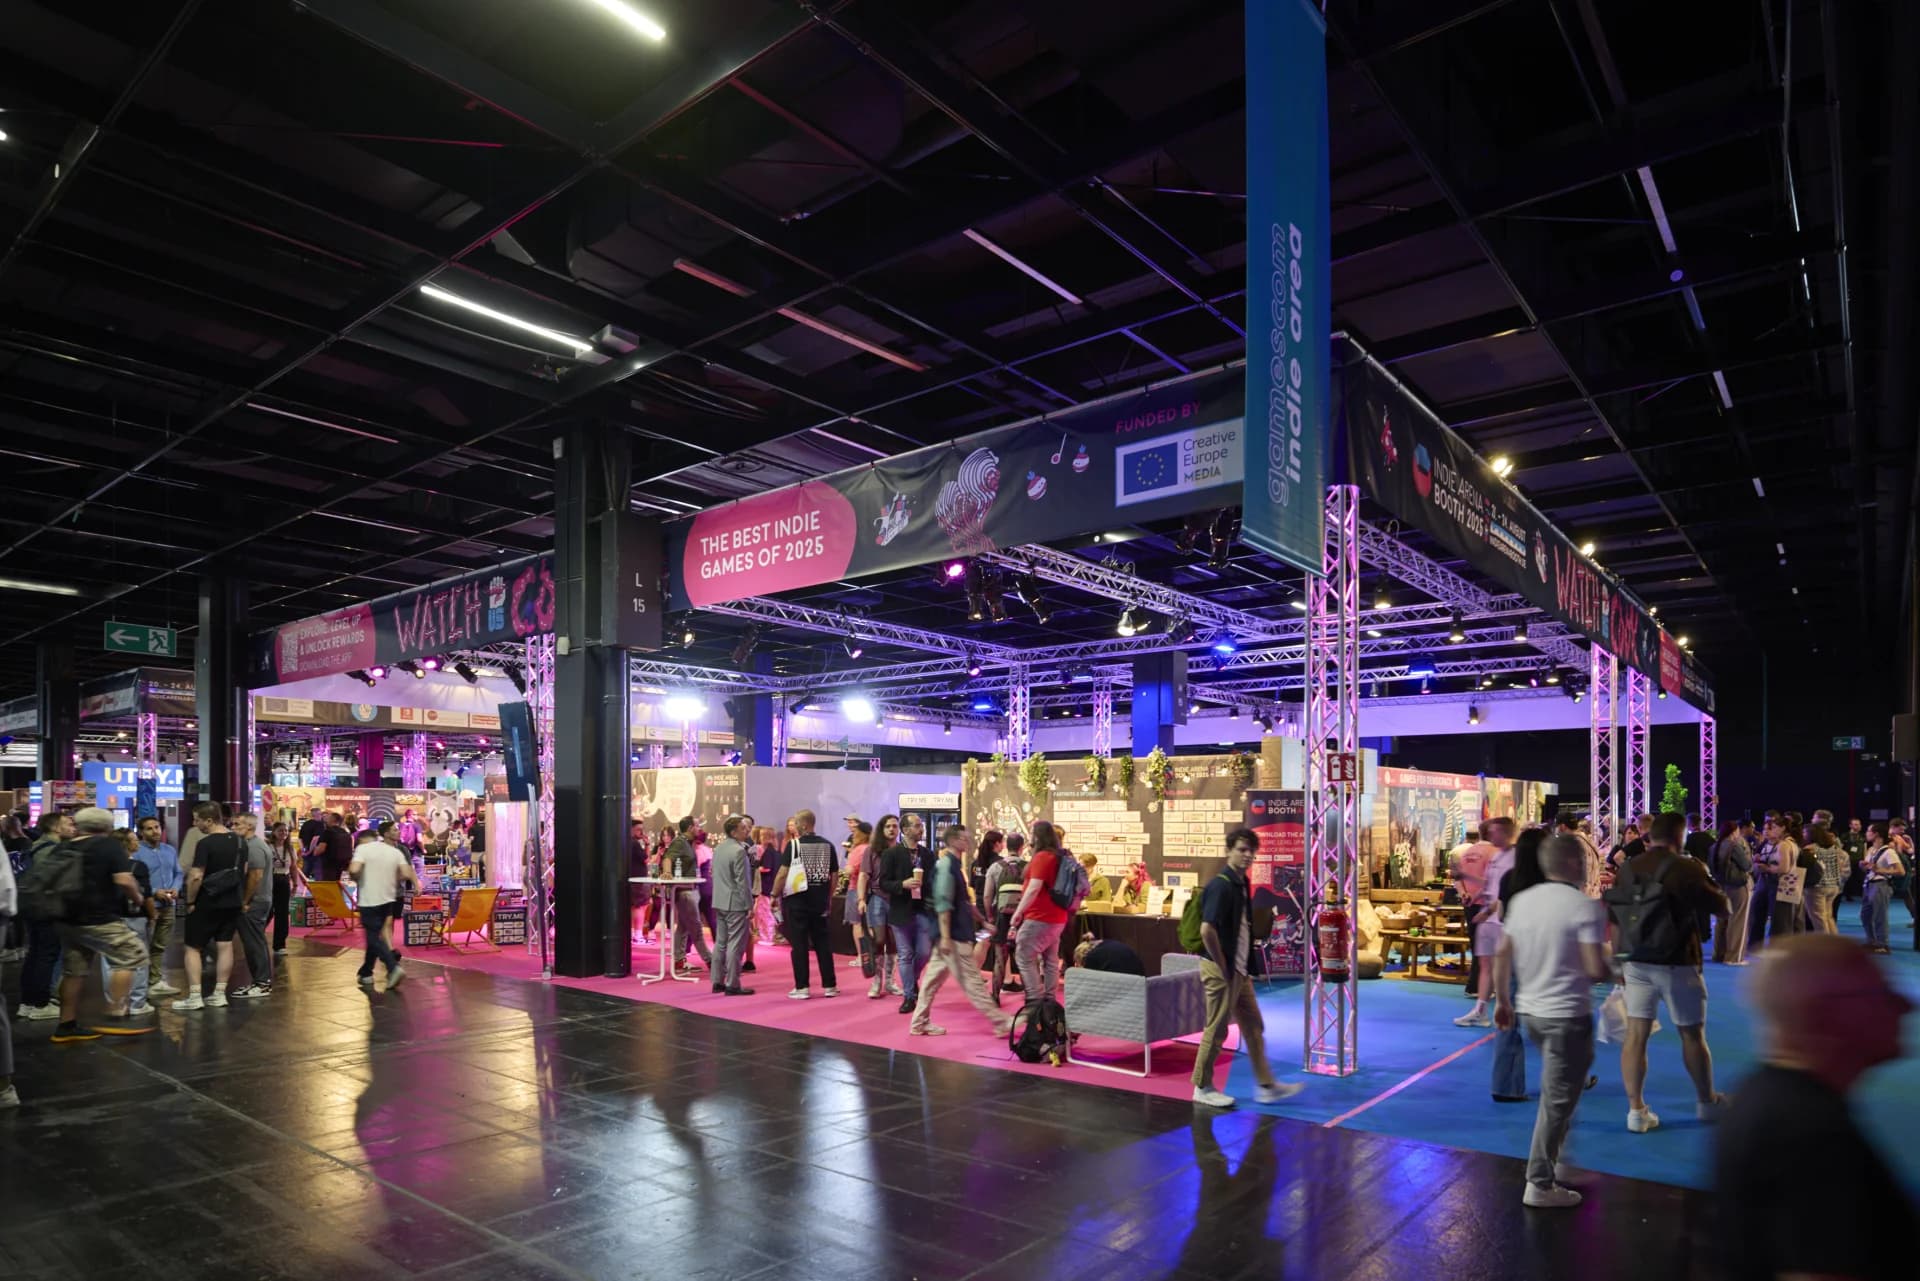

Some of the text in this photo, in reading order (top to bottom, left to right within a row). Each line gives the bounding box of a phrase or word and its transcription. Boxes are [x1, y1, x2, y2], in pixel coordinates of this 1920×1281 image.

[1268, 223, 1289, 506] gamescom
[1286, 222, 1301, 483] indie area
[1115, 401, 1201, 433] FUNDED BY
[1183, 431, 1236, 451] Creative
[1183, 448, 1228, 467] Europe
[1184, 466, 1221, 482] MEDIA
[1434, 456, 1484, 514] INDIE ARENA
[1434, 483, 1465, 524] BOOTH
[700, 510, 820, 556] THE BEST INDIE
[700, 535, 824, 579] GAMES OF 2025
[635, 572, 644, 588] L
[394, 580, 480, 652] WATCH
[487, 608, 505, 633] US
[633, 598, 645, 613] 15
[331, 616, 350, 634] LEVEL
[351, 614, 361, 626] UP
[305, 638, 332, 654] UNLOCK
[332, 630, 365, 649] REWARDS
